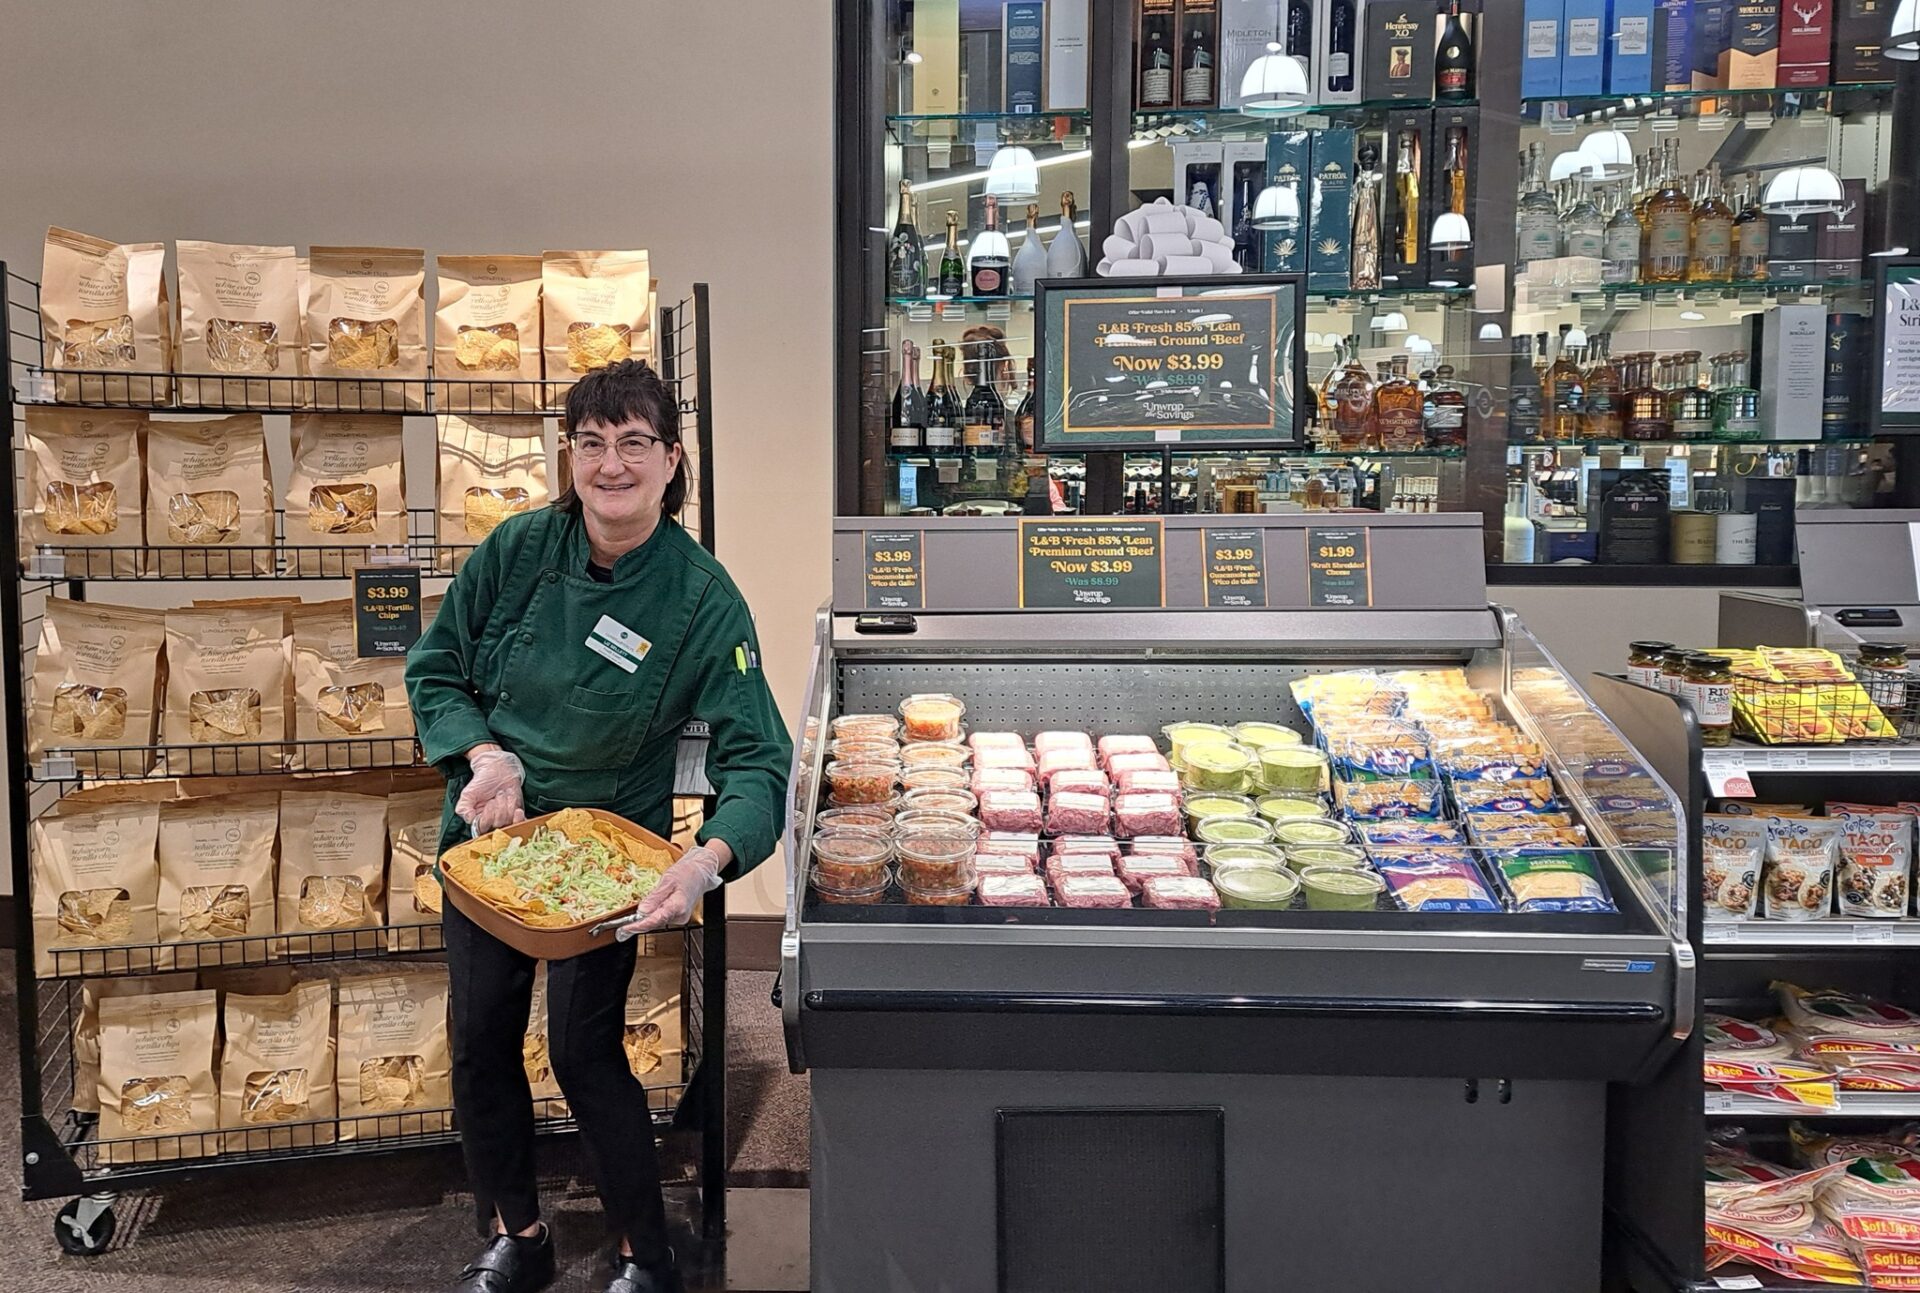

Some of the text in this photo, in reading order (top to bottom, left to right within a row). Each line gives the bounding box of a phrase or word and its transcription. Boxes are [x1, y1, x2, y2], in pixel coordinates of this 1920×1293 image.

[1738, 6, 1775, 14] MORTLACH
[1385, 22, 1419, 31] Hennessy
[1227, 29, 1272, 38] MIDLETON
[1098, 320, 1241, 334] L&B Fresh 85% Lean
[1159, 333, 1245, 346] Ground Beef
[1112, 353, 1224, 371] Now $3.99
[1830, 362, 1842, 373] 18
[1167, 373, 1206, 386] $8.99
[1142, 401, 1184, 412] Unwrap
[1156, 410, 1195, 421] Savings
[1030, 535, 1153, 545] L&B Fresh 85% Lean
[1029, 545, 1155, 556] Premium Ground Beef
[1215, 549, 1254, 561] $3.99
[1319, 546, 1355, 558] $1.99
[875, 551, 912, 563] $3.99
[1051, 560, 1133, 573] Now $3.99
[1311, 561, 1332, 569] Kraft
[1065, 577, 1119, 586] Was $8.99
[1212, 578, 1230, 586] Pico
[367, 586, 409, 599] $3.99
[1073, 589, 1104, 597] Unwrap
[378, 612, 400, 620] Chips
[1708, 687, 1730, 697] RIO
[1765, 698, 1797, 706] TACO
[1501, 802, 1520, 810] Kraft
[1383, 809, 1402, 817] Kraft
[1704, 836, 1747, 849] TACO
[1778, 836, 1822, 849] TACO
[1846, 833, 1894, 847] TACO
[1530, 859, 1568, 867] Mexican
[1864, 856, 1884, 864] mild
[1820, 1044, 1846, 1053] Soft
[1716, 1065, 1744, 1077] Taco
[1861, 1218, 1919, 1234] Soft Taco
[1708, 1225, 1760, 1249] Soft Taco
[1873, 1253, 1900, 1266] Soft
